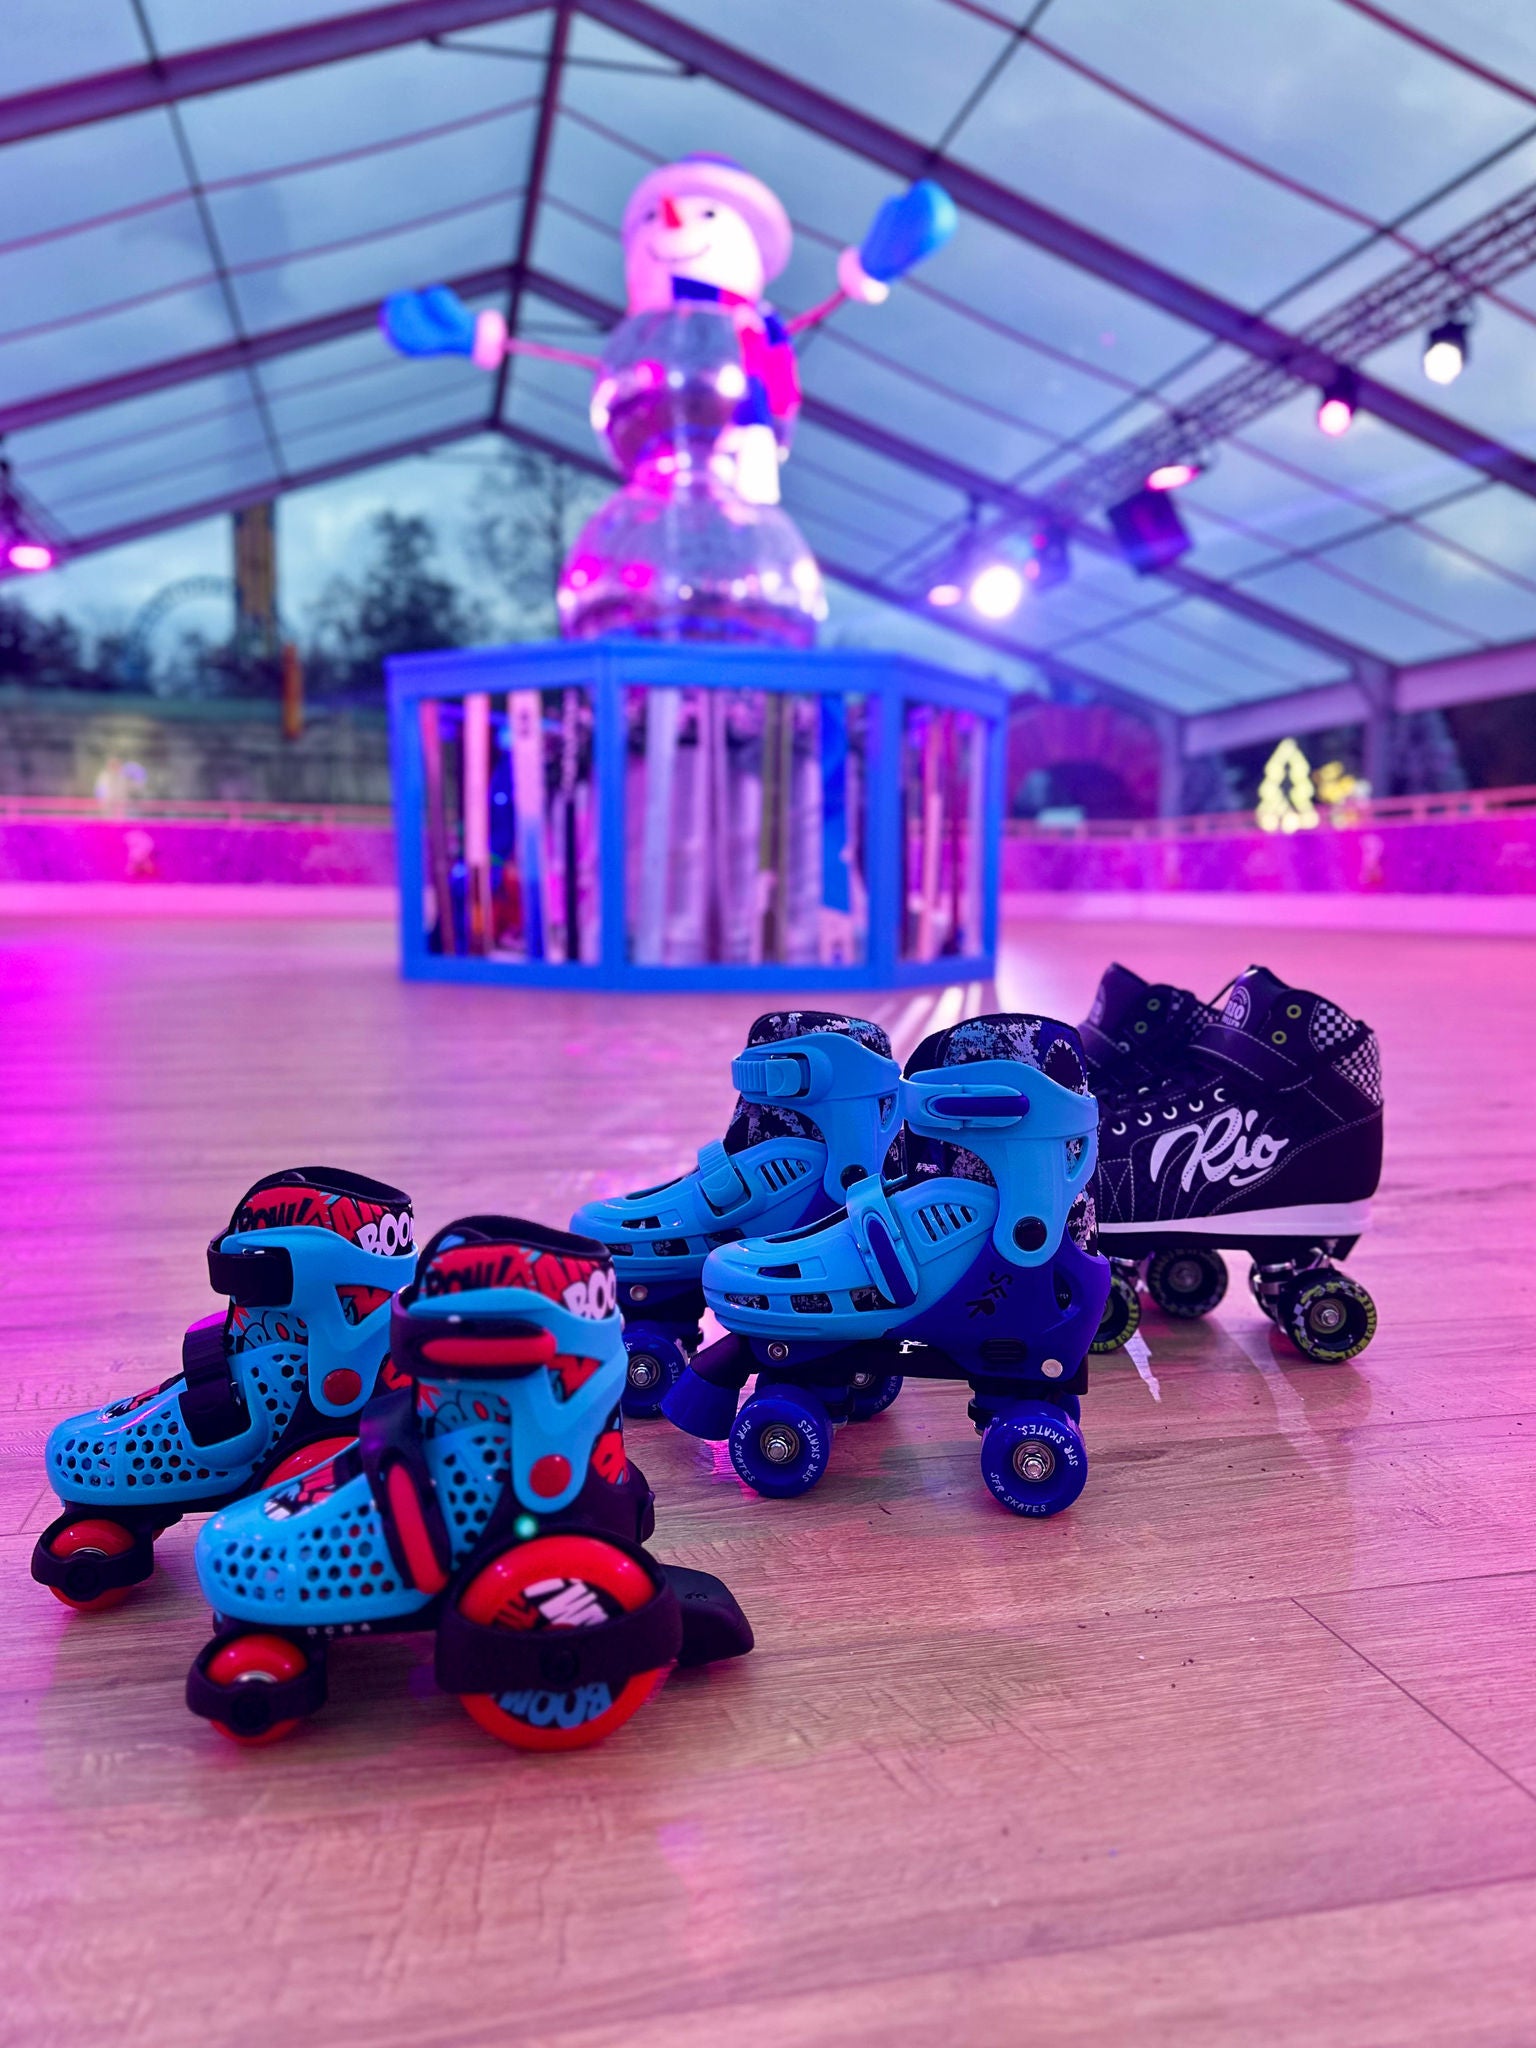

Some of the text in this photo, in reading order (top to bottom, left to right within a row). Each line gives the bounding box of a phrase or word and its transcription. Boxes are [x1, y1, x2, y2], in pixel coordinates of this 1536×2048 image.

[1150, 1107, 1290, 1193] Rio
[356, 1212, 415, 1256] BOO
[965, 1271, 1014, 1320] SFR
[734, 1419, 757, 1483] SFR SKATES
[797, 1419, 821, 1484] SFR SKATES
[1021, 1424, 1079, 1467] SFR SKATES
[990, 1471, 1047, 1513] SFR SKATES
